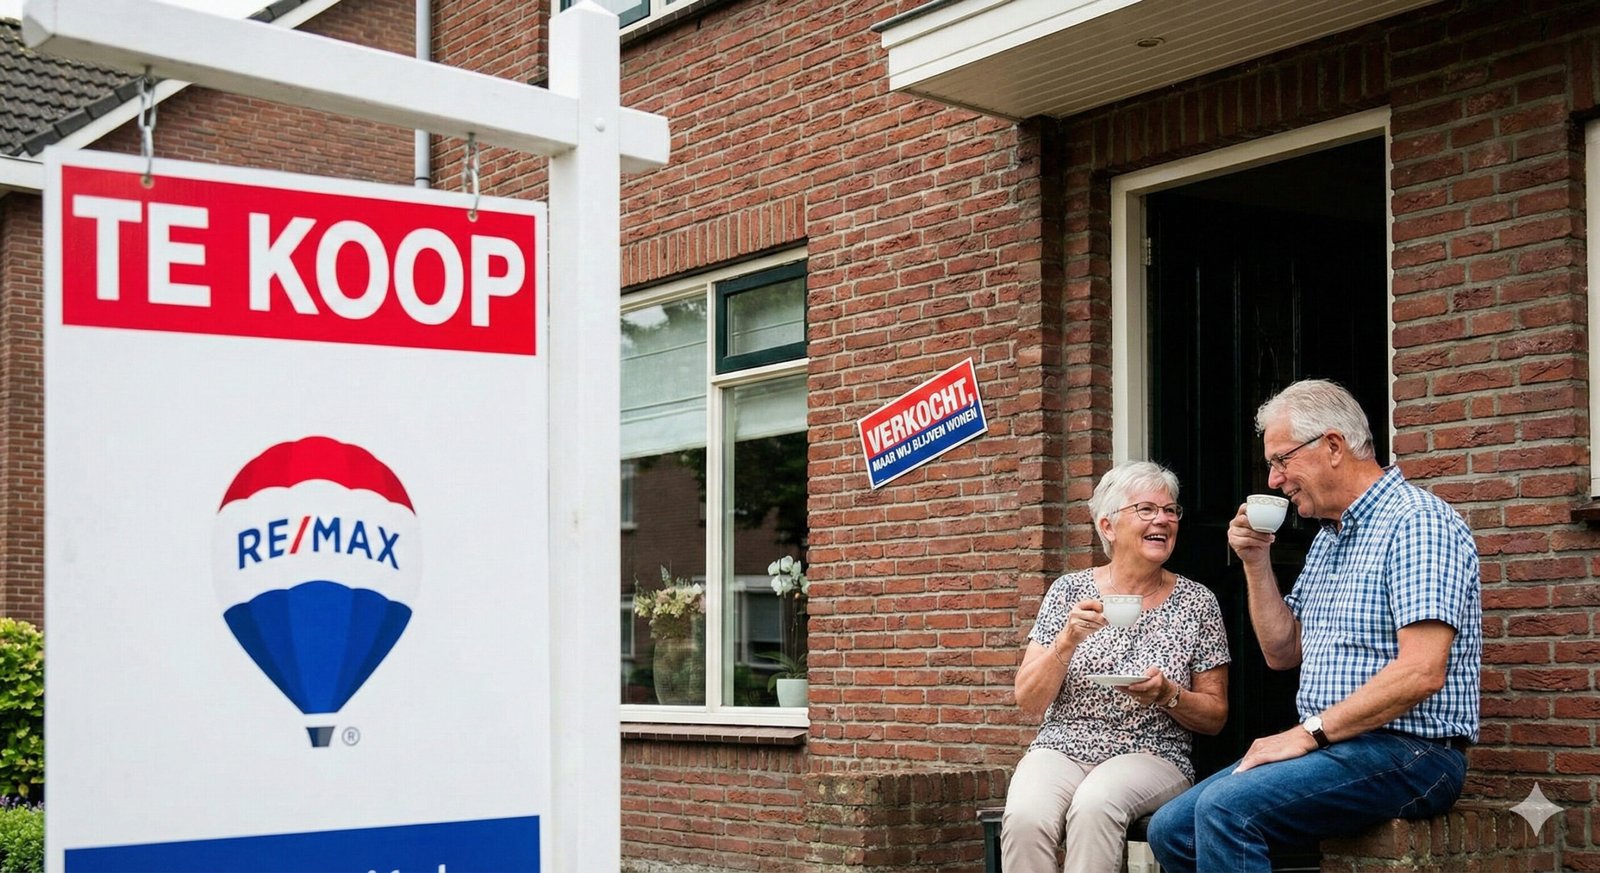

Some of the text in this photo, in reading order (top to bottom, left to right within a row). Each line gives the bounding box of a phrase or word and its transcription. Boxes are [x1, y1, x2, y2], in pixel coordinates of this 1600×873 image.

[72, 194, 526, 328] TE KOOP
[866, 378, 974, 454] VERKOCHT,
[872, 407, 978, 472] MAAR WIJ BLIJVEN WONEN
[238, 516, 399, 570] RE/MAX
